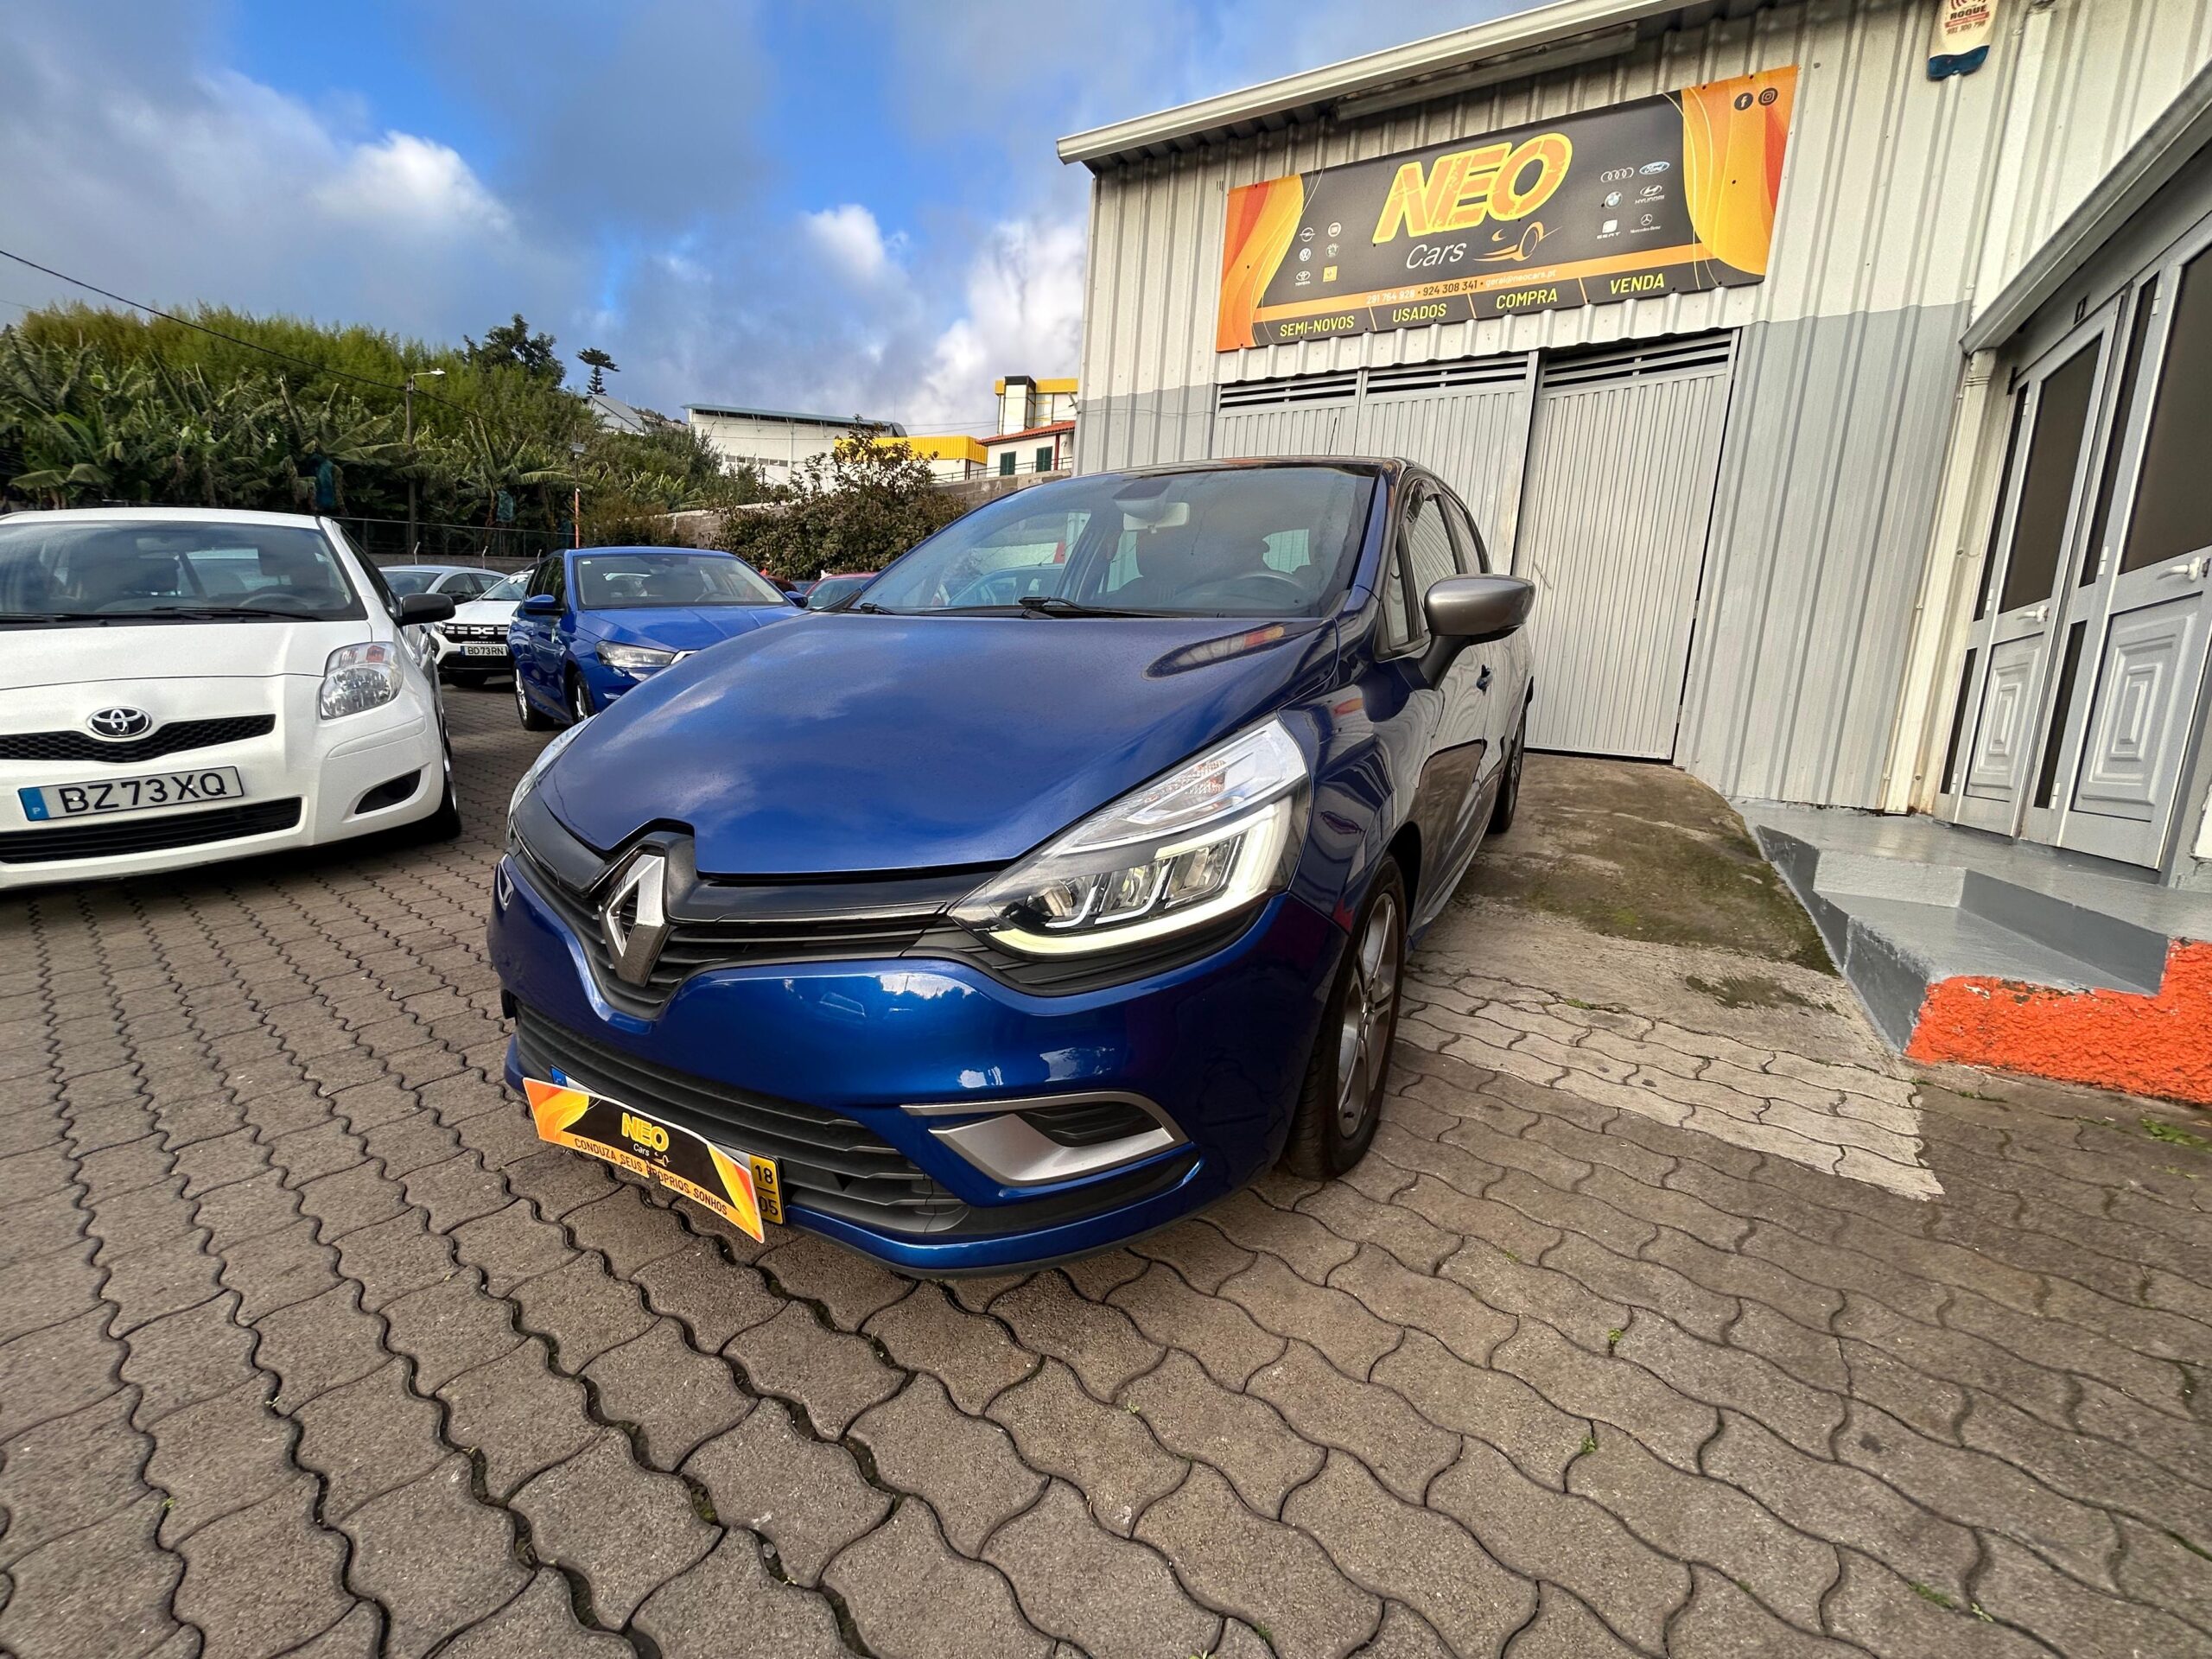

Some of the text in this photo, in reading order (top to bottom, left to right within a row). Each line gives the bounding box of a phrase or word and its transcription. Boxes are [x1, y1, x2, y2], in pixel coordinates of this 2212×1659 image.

[1372, 133, 1573, 244] NEO
[1406, 243, 1467, 269] Cars
[1423, 286, 1440, 296] 924
[1442, 283, 1459, 294] 308
[1462, 280, 1478, 290] 341
[1280, 273, 1665, 337] SEMI-NOVOS USADOS COMPRA VENDA
[621, 1112, 669, 1152] NEO
[633, 1143, 650, 1157] Cars
[575, 1138, 617, 1161] CONDUZA
[620, 1154, 643, 1173] SEUS
[693, 1188, 728, 1215] SONHOS
[754, 1165, 773, 1185] 18
[759, 1196, 779, 1216] 05
